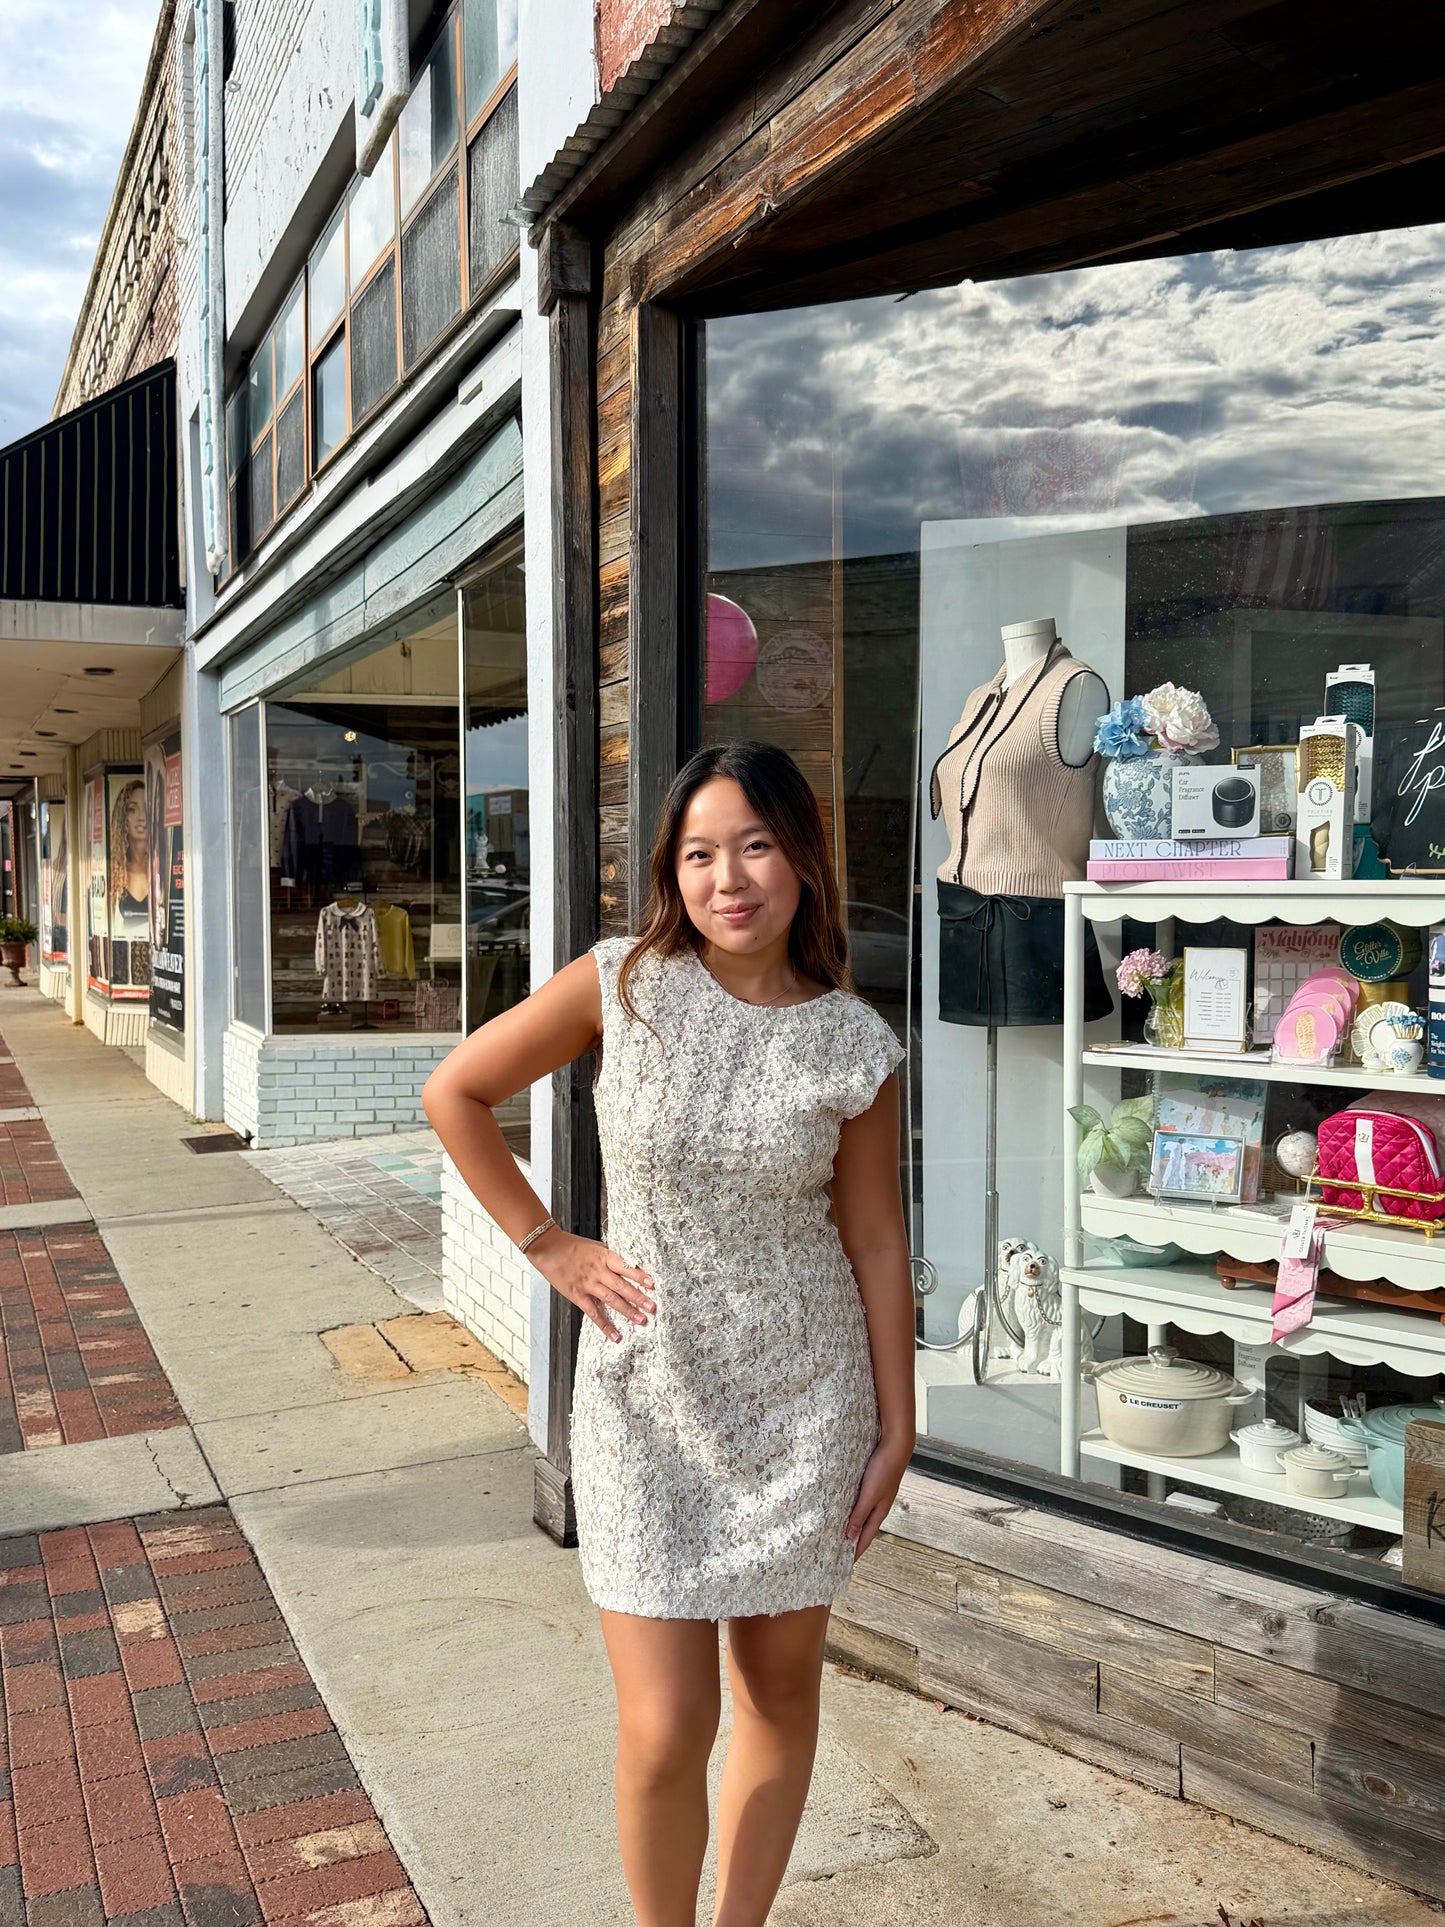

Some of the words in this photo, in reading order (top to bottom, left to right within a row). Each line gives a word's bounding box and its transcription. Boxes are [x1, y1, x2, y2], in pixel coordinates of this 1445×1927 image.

[1178, 792, 1200, 800] Diffuser
[1315, 788, 1327, 801] T
[1104, 842, 1148, 858] NEXT
[1155, 840, 1242, 857] CHAPTER
[1102, 862, 1151, 879] PLOT
[1159, 862, 1217, 878] TWIST
[1262, 928, 1340, 953] Mahjong
[1353, 941, 1382, 960] Glitter
[1364, 949, 1392, 964] Ville
[1238, 1352, 1261, 1361] Fragrance
[1129, 1398, 1140, 1406] LE
[1140, 1401, 1179, 1410] CREUSET
